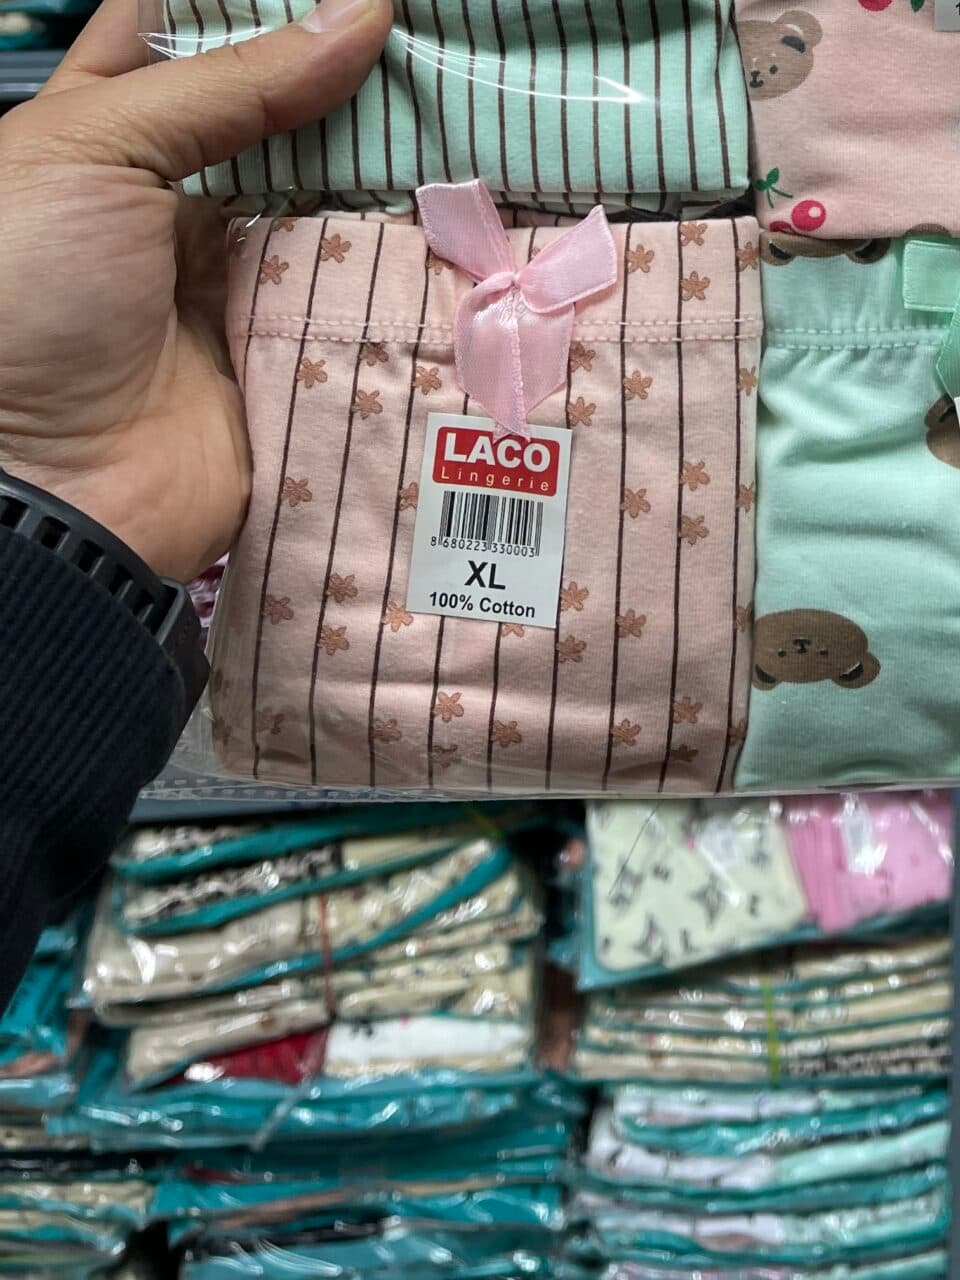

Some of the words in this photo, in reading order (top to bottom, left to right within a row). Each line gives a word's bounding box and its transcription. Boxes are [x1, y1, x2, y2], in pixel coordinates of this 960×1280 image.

[444, 433, 550, 472] LACO
[441, 467, 549, 491] Lingerie
[464, 560, 506, 590] XL
[429, 592, 473, 611] 100%
[480, 597, 535, 618] Cotton
